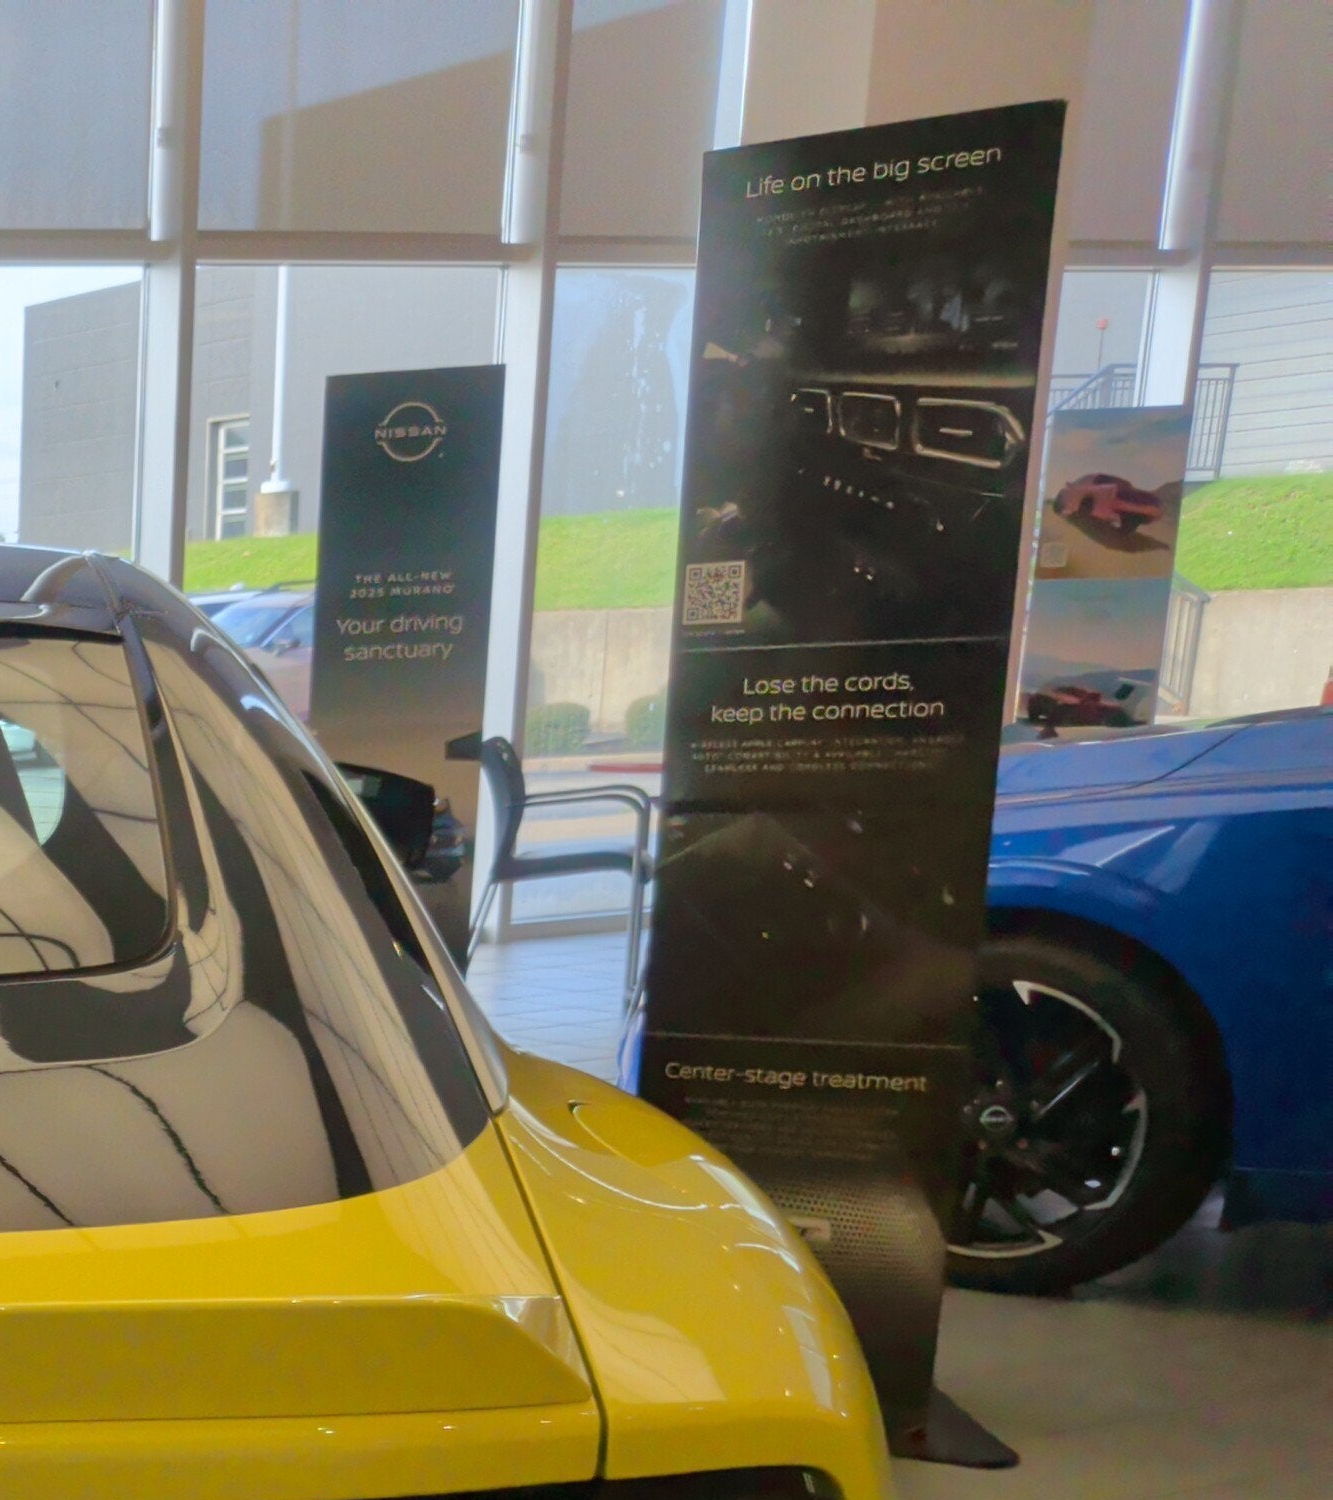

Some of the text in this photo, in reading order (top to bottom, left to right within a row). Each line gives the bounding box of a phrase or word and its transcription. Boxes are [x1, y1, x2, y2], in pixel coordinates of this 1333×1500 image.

[746, 145, 1002, 199] Life on the big screen
[374, 425, 447, 440] NISSAN
[355, 573, 382, 584] THE
[349, 587, 385, 599] 2025
[335, 614, 463, 635] Your driving
[343, 643, 454, 661] sanctuary
[743, 672, 914, 696] Lose the cords,
[711, 700, 945, 725] keep the connection
[664, 1062, 928, 1093] Center-stage treatment
